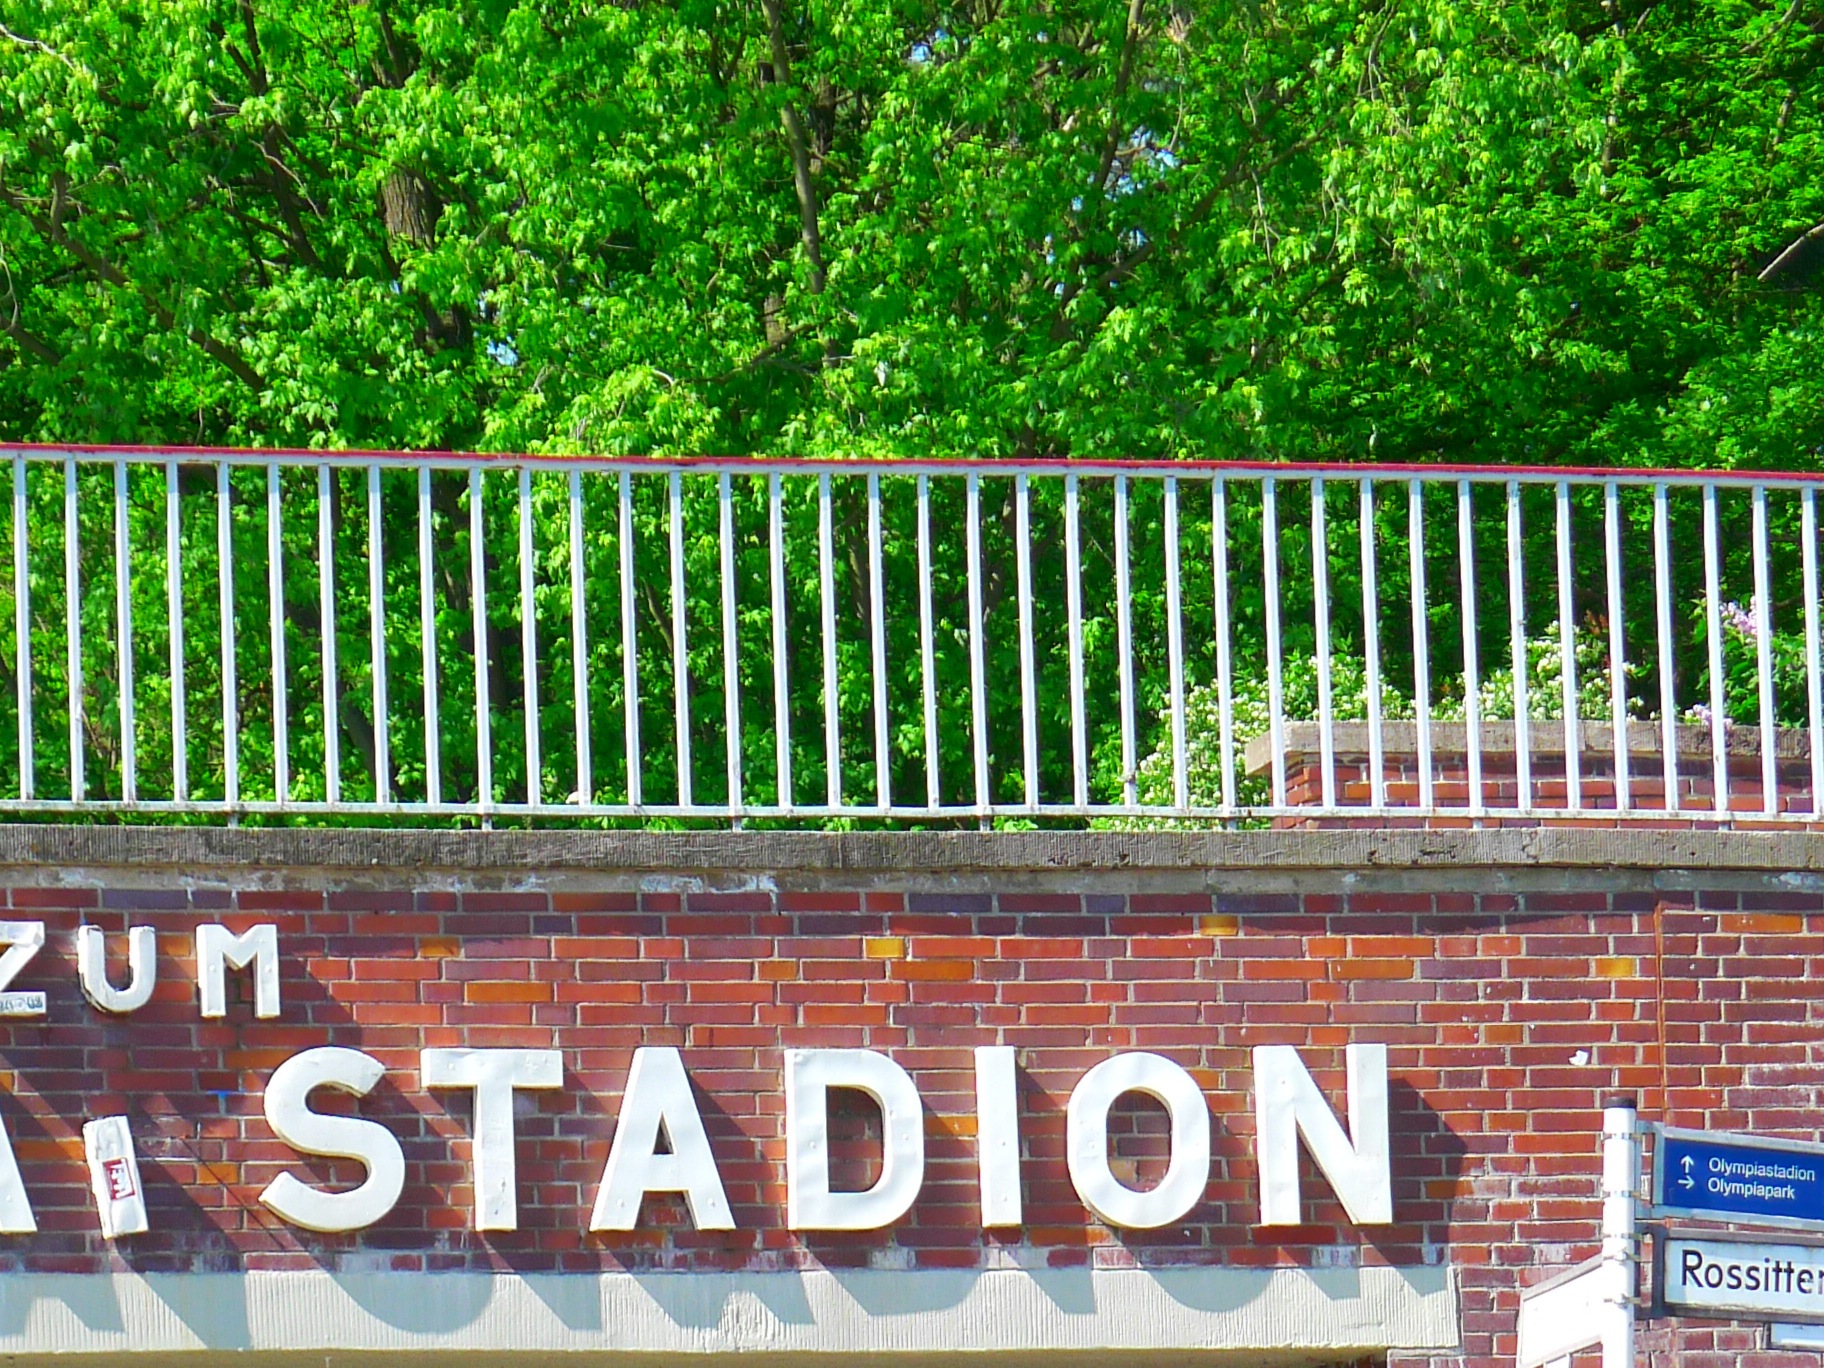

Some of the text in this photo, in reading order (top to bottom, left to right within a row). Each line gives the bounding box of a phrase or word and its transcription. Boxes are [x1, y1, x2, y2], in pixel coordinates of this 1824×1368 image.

[257, 1042, 1394, 1234] STADION
[1708, 1157, 1816, 1182] Olympiastadion
[1707, 1177, 1796, 1201] Olympiapark
